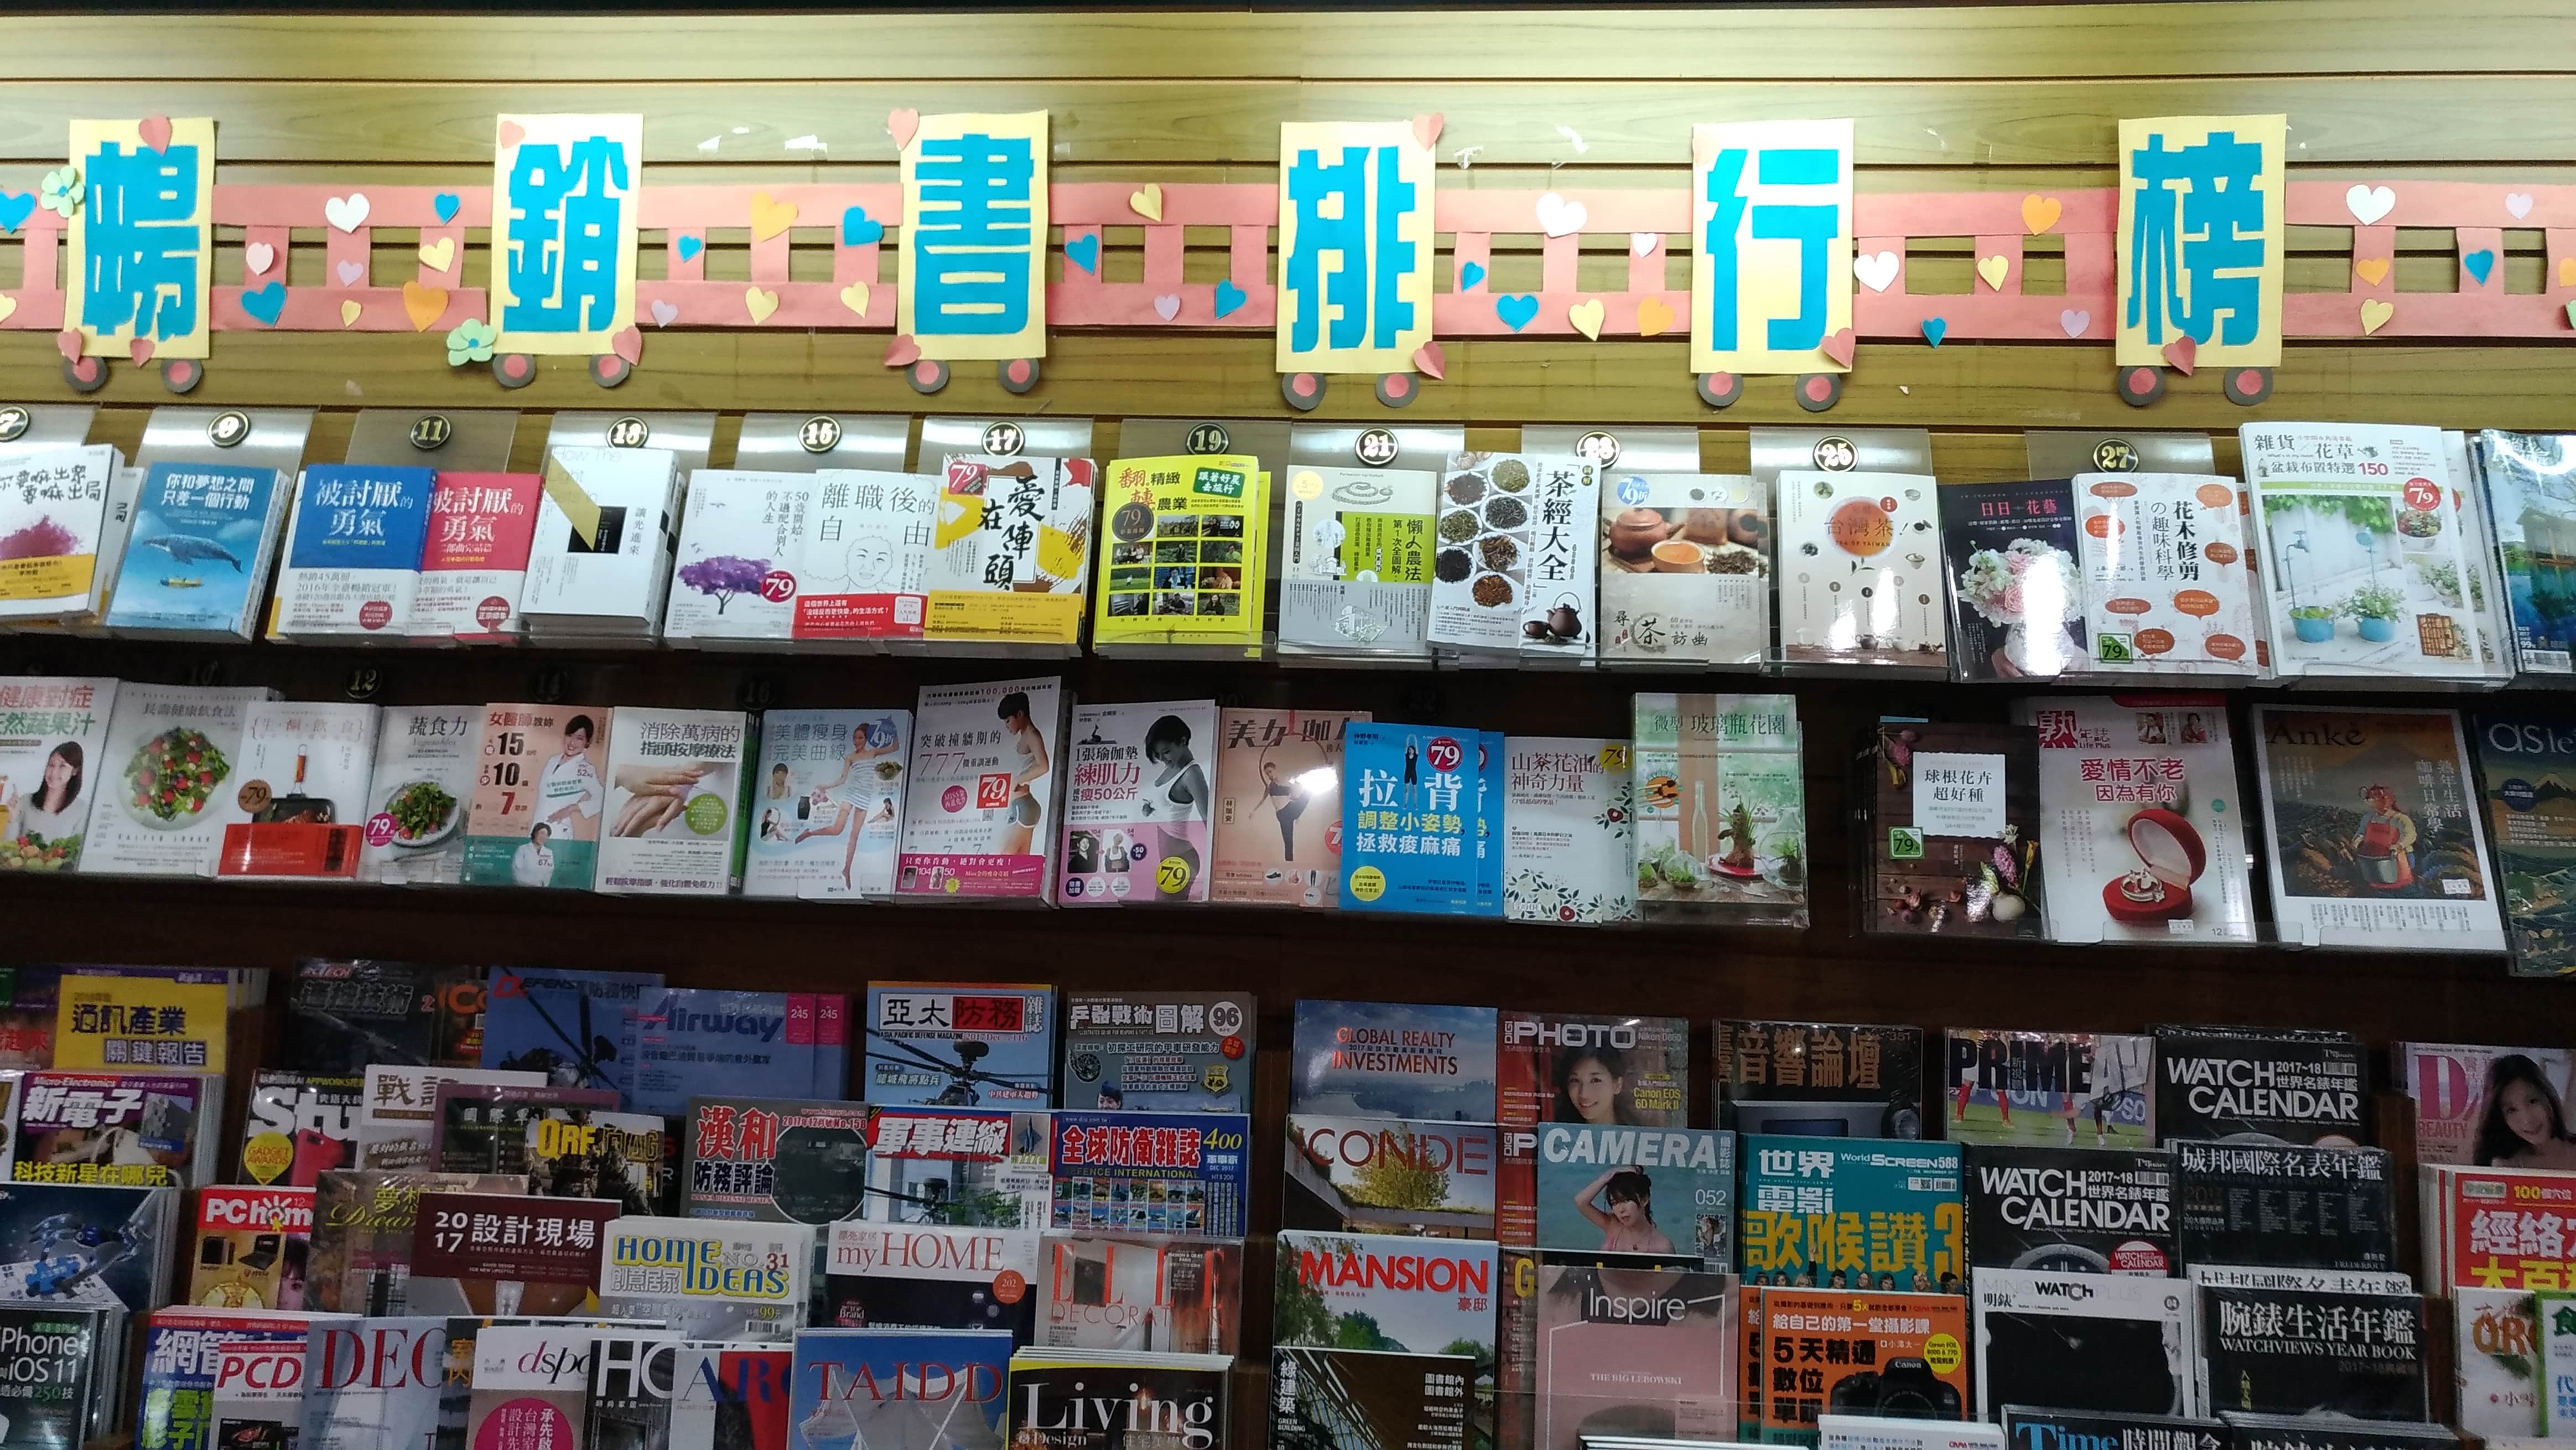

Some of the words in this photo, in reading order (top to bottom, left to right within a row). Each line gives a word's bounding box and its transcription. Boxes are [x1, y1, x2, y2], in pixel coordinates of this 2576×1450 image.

[219, 414, 240, 437] 9
[415, 420, 442, 442] 11
[803, 423, 832, 444] 15
[989, 428, 1016, 451] 17
[1194, 430, 1221, 451] 19
[1363, 434, 1390, 457] 21
[2254, 433, 2295, 452] 雜貨
[2314, 442, 2355, 460] 花草
[1822, 442, 1851, 466] 25
[2102, 444, 2129, 469] 27
[951, 464, 978, 489] 79
[1150, 472, 1181, 487] 精緻
[2269, 462, 2356, 475] 盆栽布置特選
[2357, 462, 2389, 475] 150
[166, 473, 255, 495] 你和夢想之間
[315, 478, 413, 509] 被討厭的
[1201, 483, 1235, 495] 去旅行
[2408, 486, 2434, 504] 79
[160, 490, 251, 511] 只差一個行動
[762, 490, 778, 525] 的人生
[821, 484, 936, 515] 離職後的
[1157, 496, 1188, 512] 農業
[1981, 501, 2011, 516] 日日
[2026, 499, 2059, 515] 花藝
[329, 509, 386, 537] 勇氣
[442, 515, 496, 543] 勇氣
[773, 490, 794, 558] 不過配合別人
[1120, 508, 1141, 527] 79
[1824, 517, 1894, 537] 台灣茶
[1405, 519, 1423, 582] 懶人農法
[2151, 501, 2174, 582] の趣味科學
[2173, 500, 2200, 582] 花木修剪
[766, 576, 794, 597] 79
[2102, 644, 2123, 661] 79
[352, 671, 376, 690] 12
[1, 684, 96, 708] 健康對症
[407, 715, 468, 737] 蔬食力
[640, 721, 741, 743] 消除萬病的
[1690, 713, 1786, 736] 玻璃瓶花園
[497, 732, 524, 756] 15
[640, 742, 736, 759] 指頭按摩療法
[1430, 744, 1461, 766] 79
[1511, 751, 1604, 774] 山茶花油的
[1604, 747, 1627, 765] 79
[493, 762, 520, 786] 10
[1074, 762, 1141, 786] 練肌力
[1925, 769, 1992, 786] 球根花卉
[2080, 757, 2185, 782] 愛情不老
[980, 778, 1007, 800] 79
[1080, 786, 1138, 802] 瘦50公斤
[1511, 774, 1584, 793] 神奇力量
[1933, 786, 1984, 803] 超好種
[2095, 784, 2177, 802] 因為有你
[501, 791, 516, 815] 7
[371, 819, 391, 835] 79
[1357, 833, 1462, 857] 拯救痠麻痛
[1894, 839, 1914, 853] 79
[943, 868, 955, 876] 50
[1160, 866, 1187, 889] 79
[71, 1004, 186, 1035] 通訊產業
[643, 993, 785, 1043] Airway
[791, 1008, 809, 1019] 245
[819, 1008, 838, 1019] 245
[885, 998, 1021, 1028] 亞太防務
[1024, 996, 1045, 1033] 雜誌
[1213, 1007, 1240, 1027] 96
[1336, 1026, 1400, 1048] GLOBAL
[1402, 1029, 1456, 1050] REALTY
[1504, 1021, 1513, 1044] DIGI
[1513, 1021, 1636, 1049] PHOTO
[1638, 1032, 1660, 1041] Nikon
[105, 1040, 206, 1065] 關鍵報告
[1332, 1050, 1458, 1076] INVESTMENTS
[1738, 1028, 1881, 1090] 音響論壇
[1949, 1037, 2092, 1094] PRIME
[2167, 1057, 2276, 1088] WATCH
[2276, 1061, 2321, 1075] 2017~18
[33, 1076, 116, 1088] Micro-Electronics
[1633, 1087, 1662, 1099] Canon
[1663, 1089, 1682, 1100] EOS
[2276, 1075, 2358, 1092] 世界名錶年鑑
[21, 1087, 144, 1128] 新電子
[1635, 1099, 1648, 1109] 6D
[1649, 1100, 1671, 1110] Mark
[2189, 1086, 2359, 1121] CALENDAR
[696, 1106, 778, 1161] 漢和
[833, 1117, 868, 1130] No.158
[2418, 1121, 2468, 1138] BEAUTY
[872, 1116, 1009, 1156] 軍事連線
[1061, 1125, 1202, 1168] 全球防衛雜誌
[1203, 1127, 1243, 1150] 400
[1503, 1132, 1513, 1157] DIGI
[1543, 1128, 1718, 1169] CAMERA
[1758, 1149, 1835, 1179] 世界
[1840, 1152, 1871, 1162] World
[1938, 1156, 1959, 1169] 588
[2181, 1147, 2384, 1182] 城邦國際名表年鑑
[14, 1161, 168, 1187] 科技新星在哪兒
[692, 1160, 776, 1195] 防務評論
[1063, 1168, 1112, 1177] DEFENCE
[1114, 1168, 1200, 1179] INTERNATIONAL
[1981, 1166, 2087, 1198] WATCH
[2088, 1170, 2133, 1184] 2017~18
[1695, 1189, 1727, 1206] 052
[1758, 1184, 1834, 1214] 電影
[2087, 1185, 2170, 1203] 世界名錶年鑑
[206, 1198, 247, 1225] PC
[435, 1212, 468, 1230] 20
[2001, 1198, 2171, 1232] CALENDAR
[471, 1213, 596, 1249] 設計現場
[435, 1232, 464, 1254] 17
[836, 1243, 878, 1274] my
[879, 1231, 1006, 1272] HOME
[610, 1267, 682, 1294] 創意居家
[1299, 1250, 1488, 1294] MANSION
[1001, 1280, 1017, 1288] 202
[1457, 1297, 1488, 1313] 豪邸
[1590, 1287, 1686, 1322] Inspire
[1772, 1313, 1931, 1335] 給自己的第一堂攝影課
[2218, 1299, 2417, 1345] 腕錶生活年鑑
[1773, 1336, 1876, 1365] 5天精通
[2219, 1337, 2324, 1357] WATCHVIEWS
[2327, 1342, 2369, 1359] YEAR
[2372, 1344, 2417, 1361] BOOK
[9, 1355, 48, 1384] iOS
[56, 1358, 77, 1384] 11
[216, 1356, 303, 1389] PCD
[1894, 1360, 1922, 1370] Canon
[1278, 1360, 1297, 1414] 綠建築
[1424, 1373, 1464, 1386] 圖書館內
[1590, 1374, 1608, 1382] THE
[1610, 1374, 1625, 1382] BIG
[1628, 1375, 1682, 1386] LEBOWSKI
[1773, 1367, 1824, 1394] 數位
[1424, 1385, 1464, 1398] 圖書館外
[1018, 1381, 1214, 1449] Living
